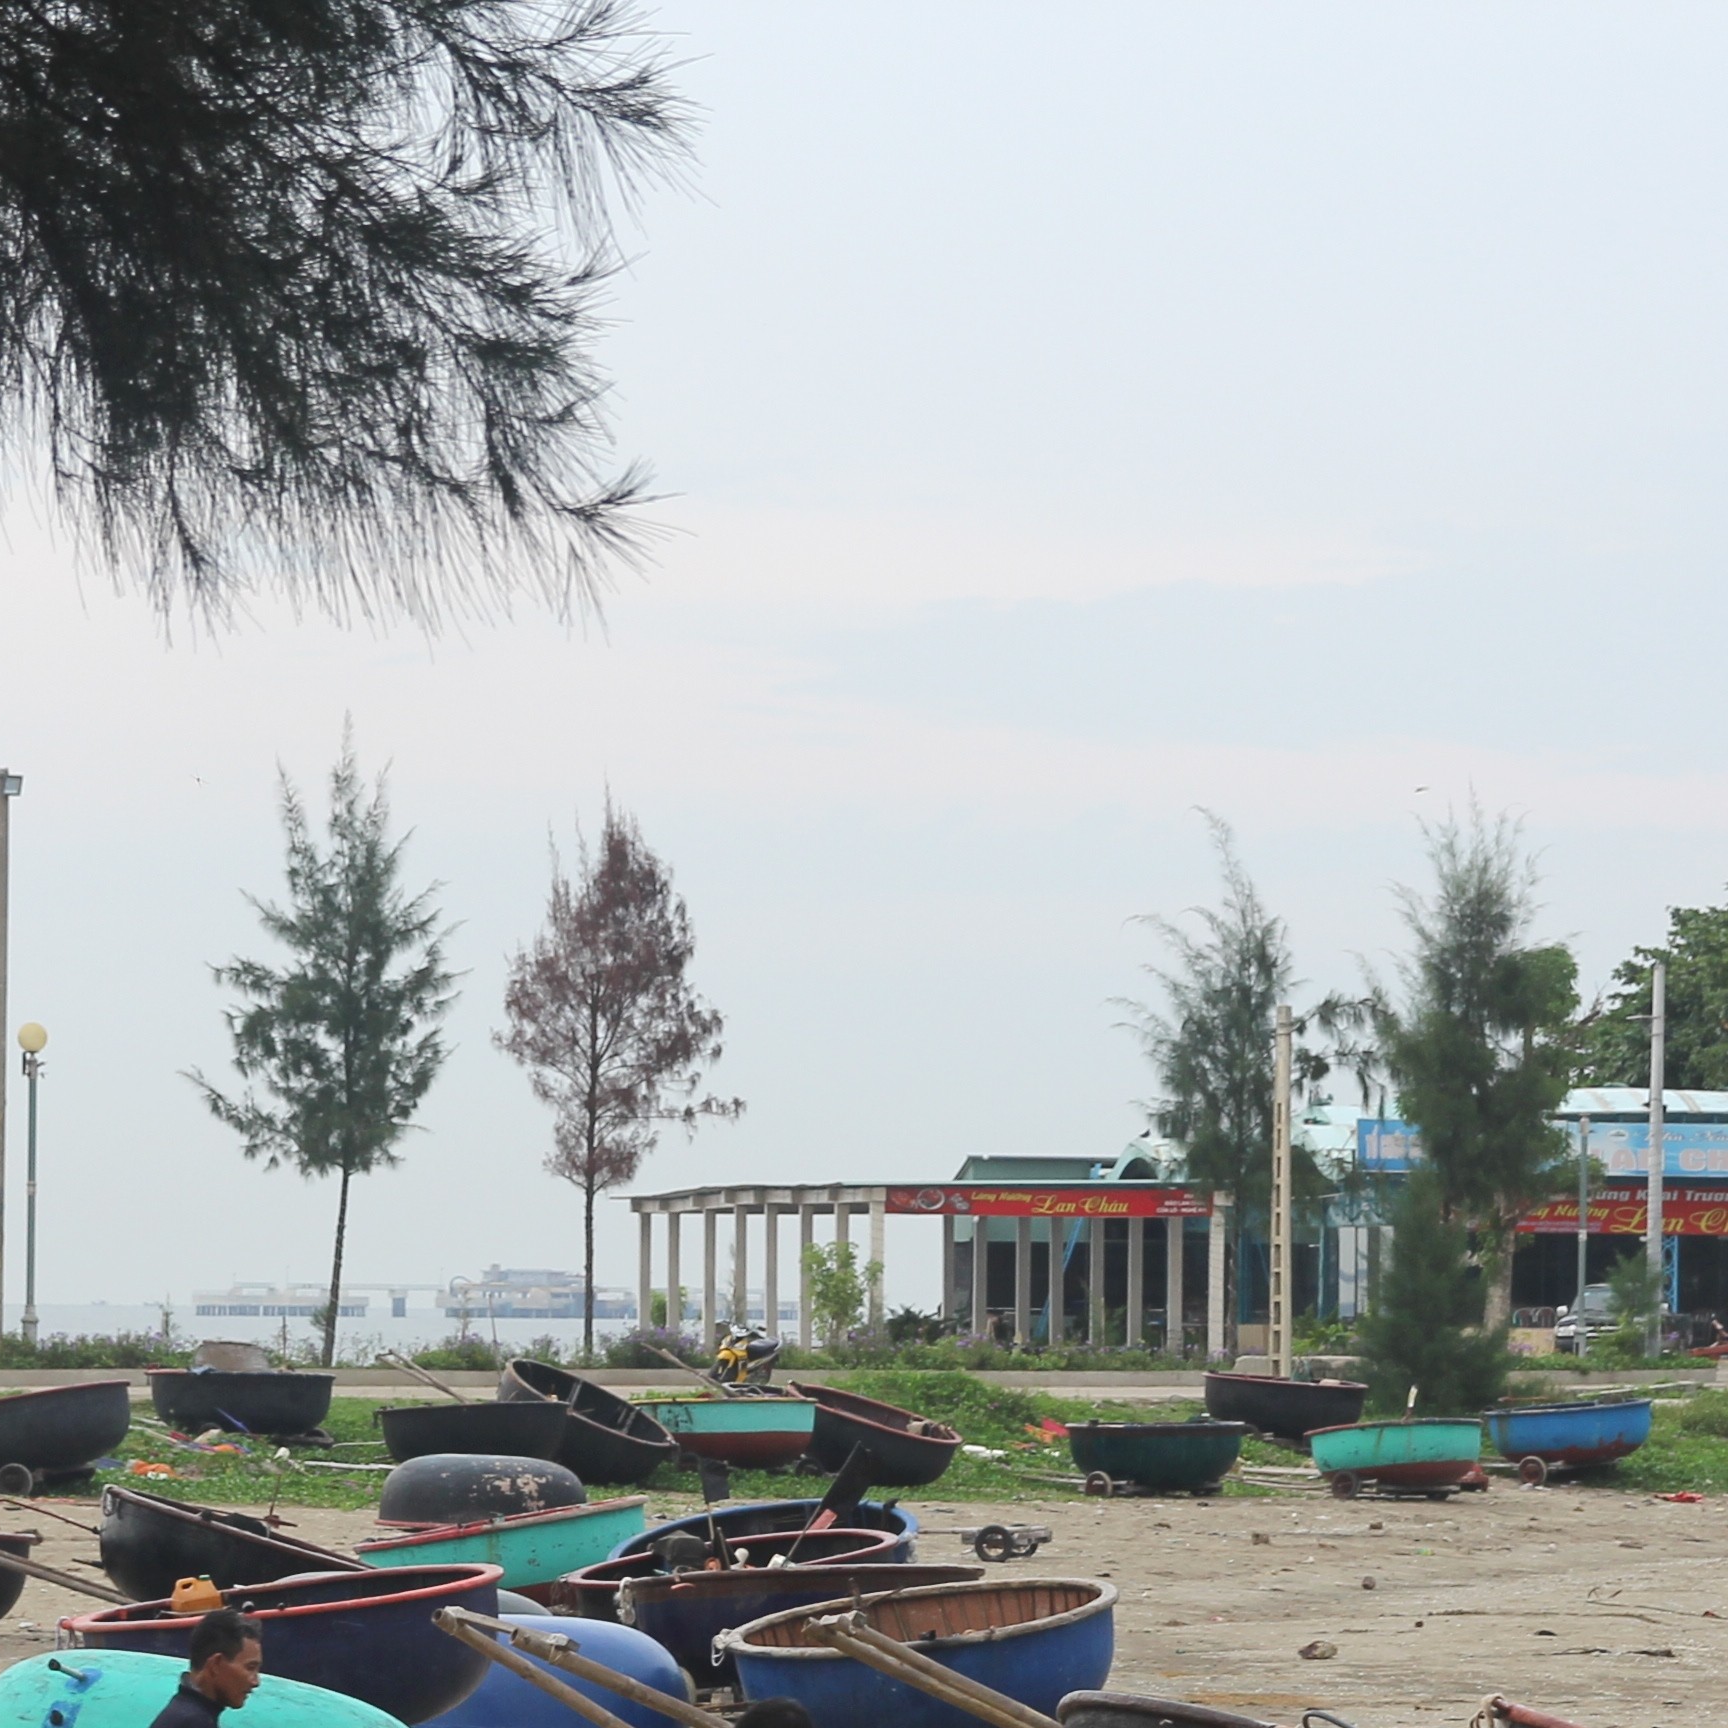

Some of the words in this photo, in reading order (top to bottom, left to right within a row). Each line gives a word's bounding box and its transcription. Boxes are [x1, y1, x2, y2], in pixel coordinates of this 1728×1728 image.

[1031, 1194, 1076, 1214] Lan
[1635, 1189, 1678, 1201] Kai
[1609, 1206, 1685, 1233] Ln
